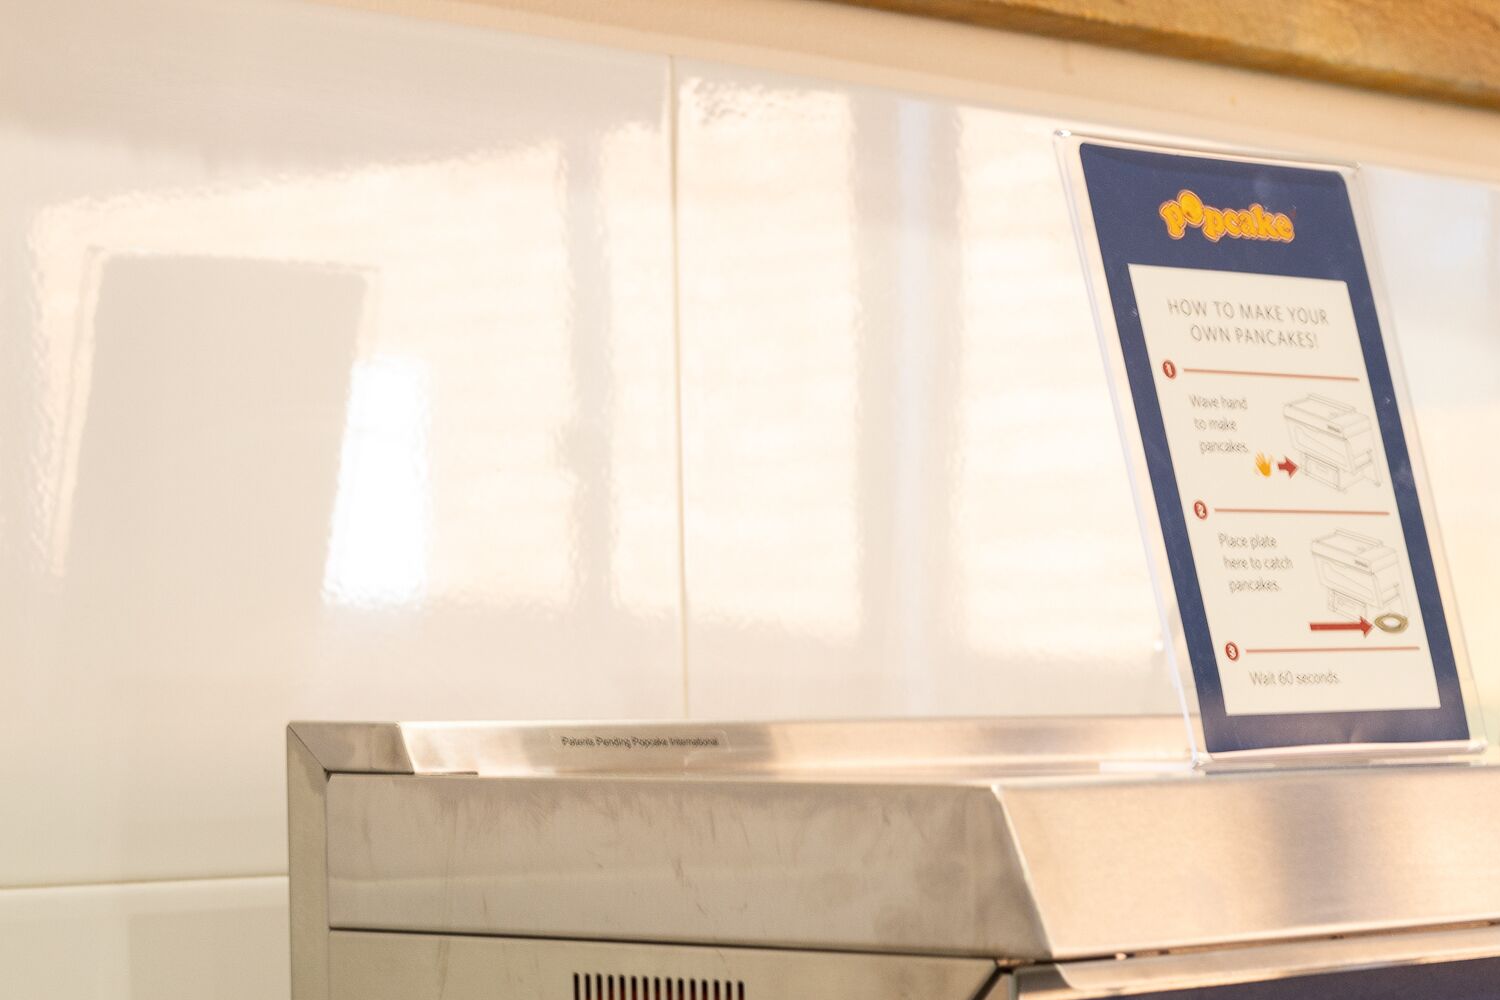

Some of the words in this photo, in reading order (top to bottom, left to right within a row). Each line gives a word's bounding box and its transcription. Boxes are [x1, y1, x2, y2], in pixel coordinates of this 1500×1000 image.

[1160, 189, 1295, 243] popcake
[1167, 299, 1207, 317] HOW
[1213, 301, 1235, 318] TO
[1239, 304, 1284, 322] MAKE
[1287, 307, 1328, 325] YOUR
[1190, 325, 1231, 342] OWN
[1235, 328, 1319, 349] PANCAKES!
[1190, 395, 1219, 409] Wave
[1221, 396, 1248, 410] hand
[1194, 418, 1206, 430] to
[1208, 418, 1237, 431] make
[1218, 532, 1248, 548] Place
[1250, 534, 1277, 550] plate
[1223, 555, 1248, 570] here
[1250, 556, 1261, 570] to
[1263, 556, 1293, 570] catch
[1249, 670, 1275, 686] Wait
[1278, 670, 1293, 686] 60
[595, 736, 631, 749] Pending
